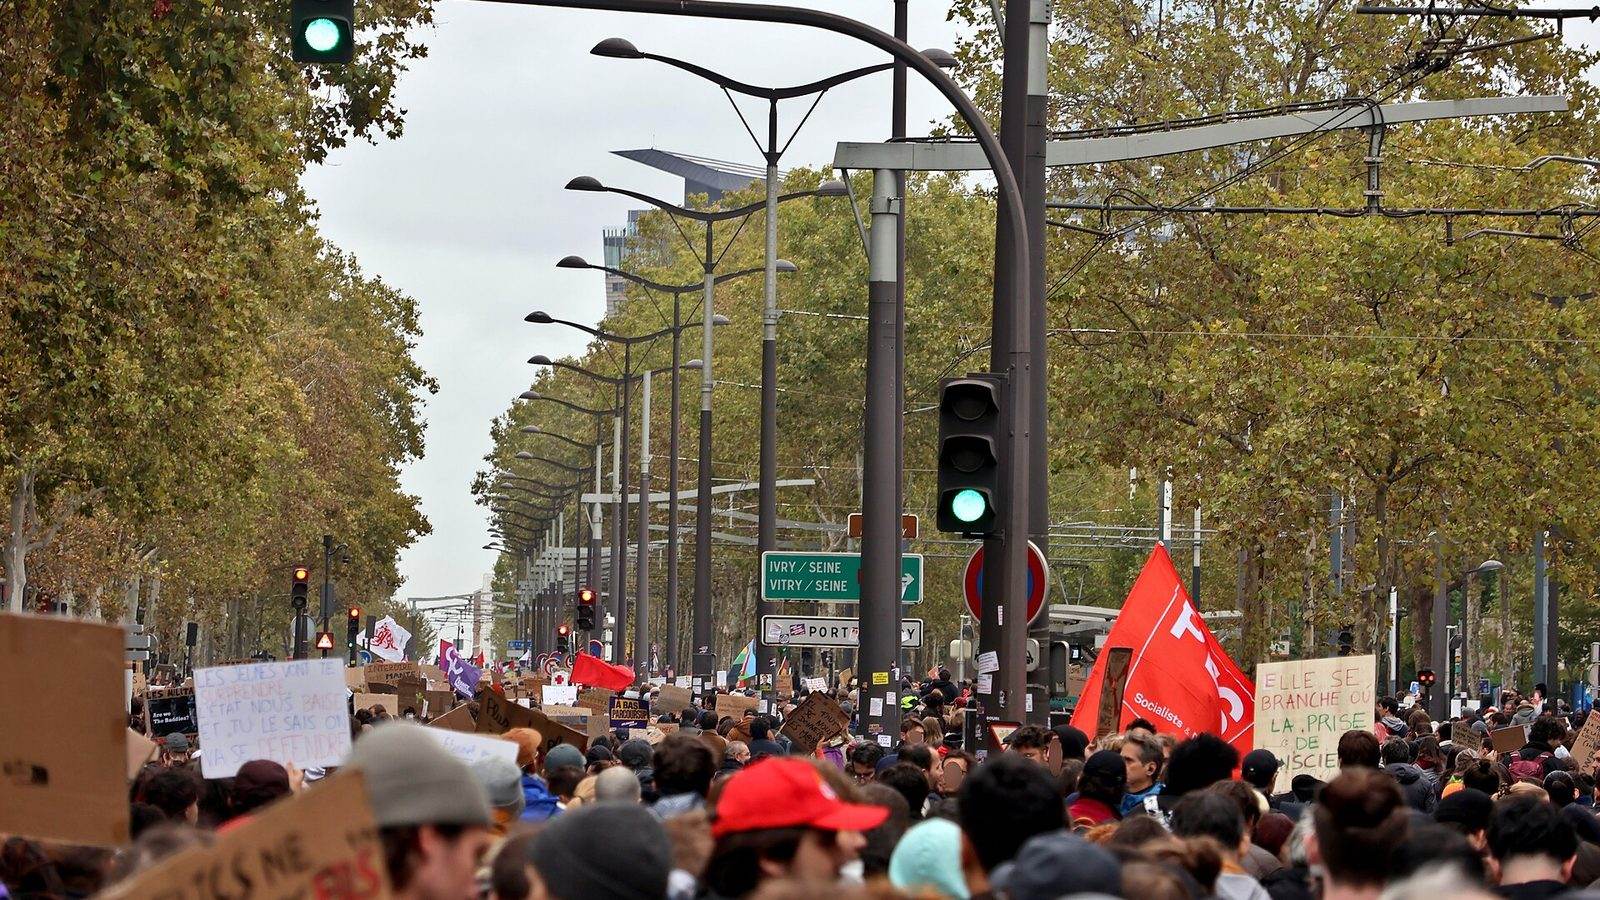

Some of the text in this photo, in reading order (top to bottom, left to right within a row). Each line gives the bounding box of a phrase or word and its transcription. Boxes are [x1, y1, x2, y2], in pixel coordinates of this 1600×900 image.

[769, 561, 796, 573] IVRY
[808, 562, 842, 574] SEINE
[769, 579, 803, 591] VITRY
[815, 580, 848, 592] SEINE
[809, 626, 849, 638] PORT
[1265, 667, 1360, 691] ELLE SE
[167, 687, 195, 697] MILITA
[250, 695, 294, 714] NOUS
[623, 701, 639, 710] BAS
[1261, 691, 1342, 711] BRANCHE
[1133, 692, 1184, 729] Socialists
[231, 718, 251, 734] TU
[262, 715, 278, 733] LE
[283, 715, 316, 731] SAIS
[1271, 712, 1366, 733] LA PRISE
[1296, 736, 1319, 751] DE
